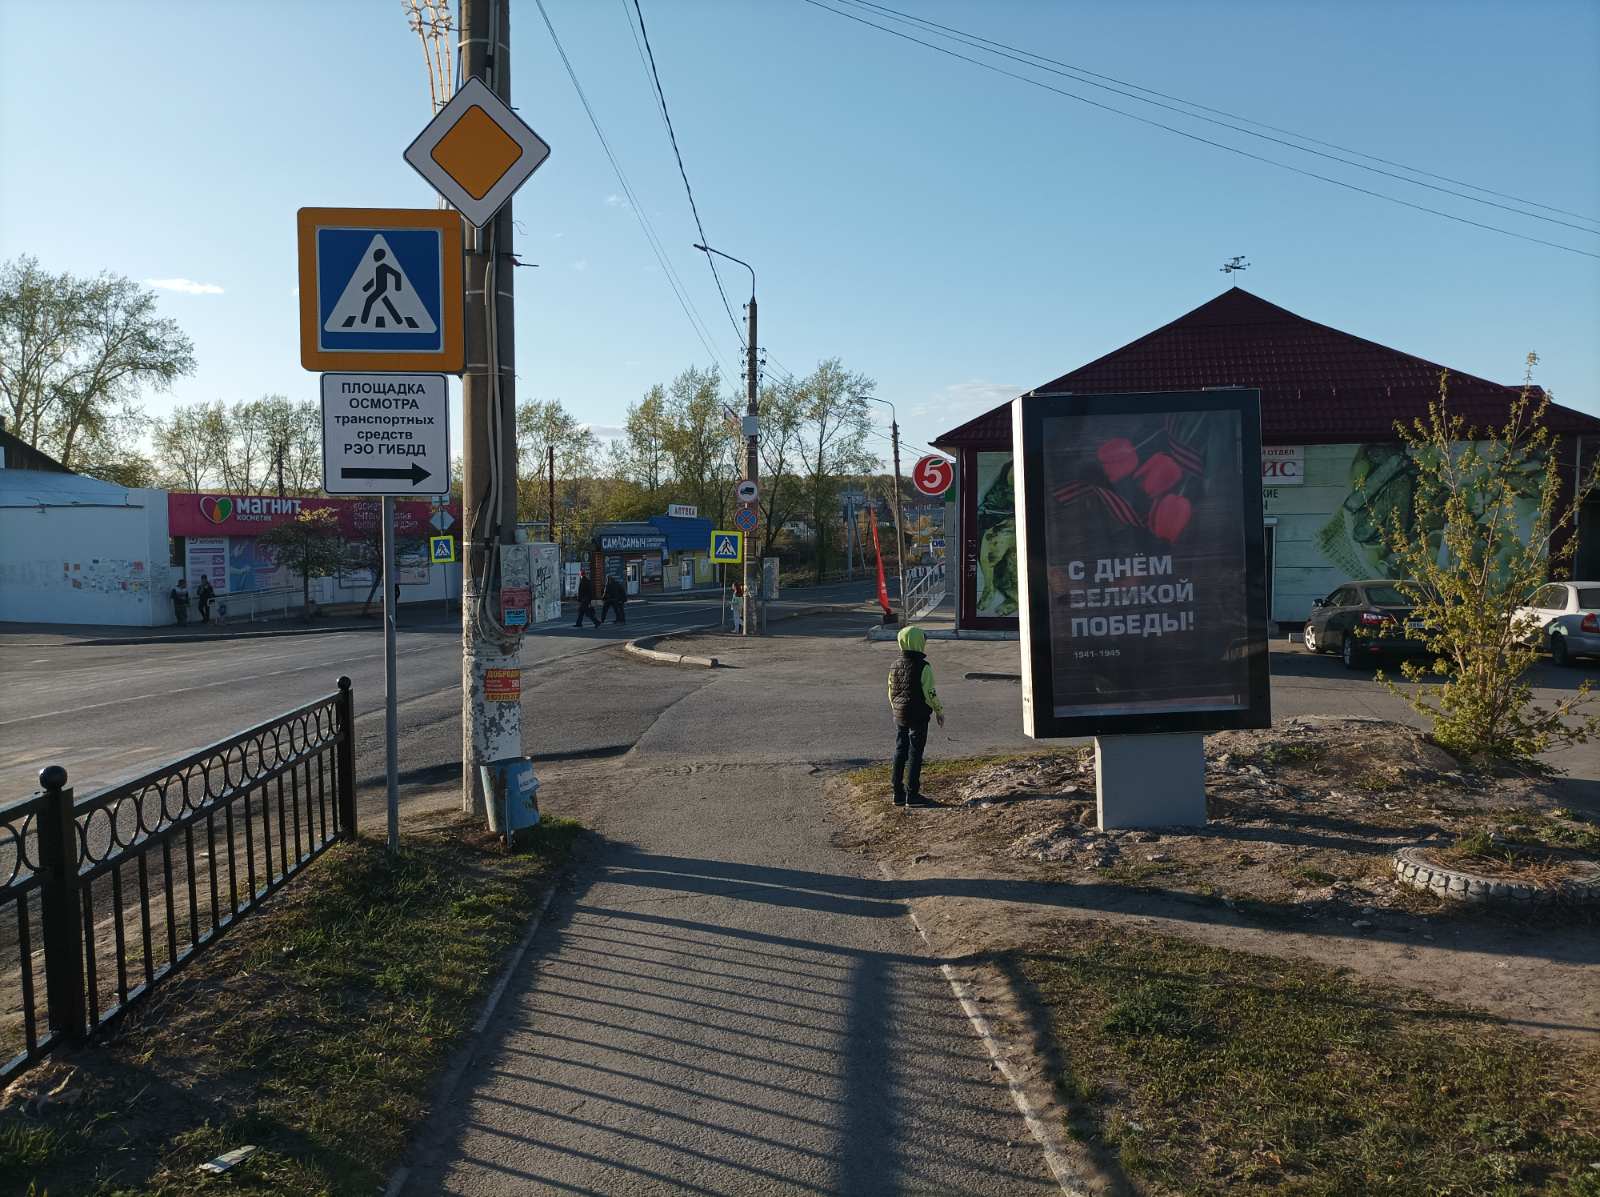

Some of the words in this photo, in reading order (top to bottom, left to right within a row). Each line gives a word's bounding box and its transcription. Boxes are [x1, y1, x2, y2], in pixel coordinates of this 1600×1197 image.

[341, 382, 426, 396] ПЛОЩАДКА
[349, 398, 420, 410] ОСМОТРА
[334, 415, 435, 427] транспортных
[357, 430, 413, 442] средств
[344, 443, 374, 455] РЭО
[378, 444, 427, 457] ГИБДД
[1267, 449, 1295, 457] ОТДЕЛ
[674, 505, 696, 517] АПТЕКА
[1068, 560, 1085, 580] С
[1094, 552, 1173, 583] ДНЁМ
[1070, 578, 1194, 609] ВЕЛИКОЙ
[1071, 611, 1194, 638] ПОБЕДЫ!
[1074, 649, 1121, 660] 1941-1945
